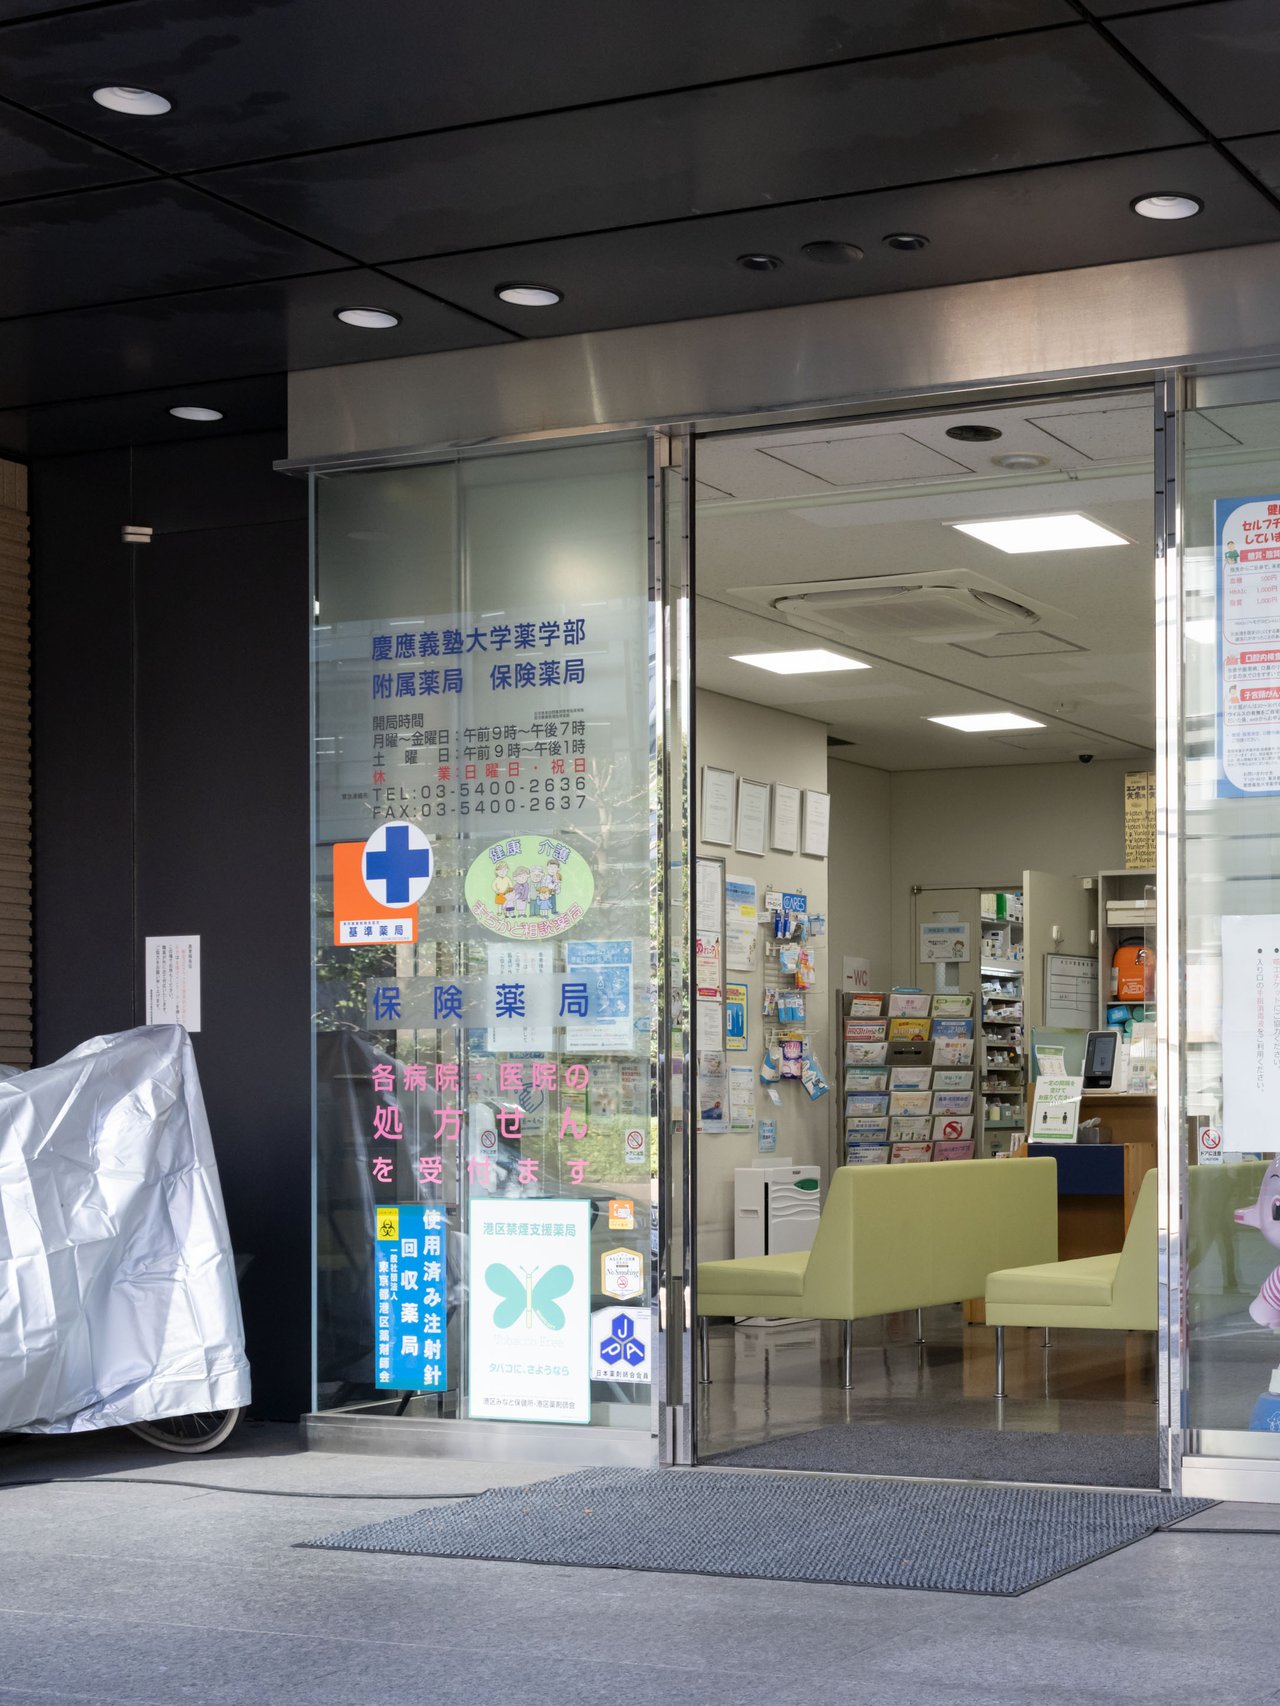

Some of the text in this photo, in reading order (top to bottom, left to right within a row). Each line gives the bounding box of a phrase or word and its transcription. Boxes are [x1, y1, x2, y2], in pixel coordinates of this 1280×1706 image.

[371, 617, 586, 661] 慶應義塾大学薬学部
[372, 658, 585, 700] 附属薬局 保険薬局
[373, 713, 424, 731] 開局時間
[489, 839, 572, 864] 健康 介護
[349, 925, 404, 938] 基準薬局
[372, 982, 590, 1021] 保険薬局
[371, 1063, 590, 1092] 各病院・医院の
[372, 1105, 588, 1140] 処方せん
[372, 1156, 590, 1185] を受付ます
[483, 1221, 577, 1238] 港区禁煙支援薬局
[390, 1248, 398, 1301] 一般社団法人
[401, 1238, 419, 1357] 回収薬局
[423, 1209, 442, 1386] 使用済み注射針
[379, 1260, 390, 1384] 東京都港区薬剤師会
[618, 1318, 628, 1338] J
